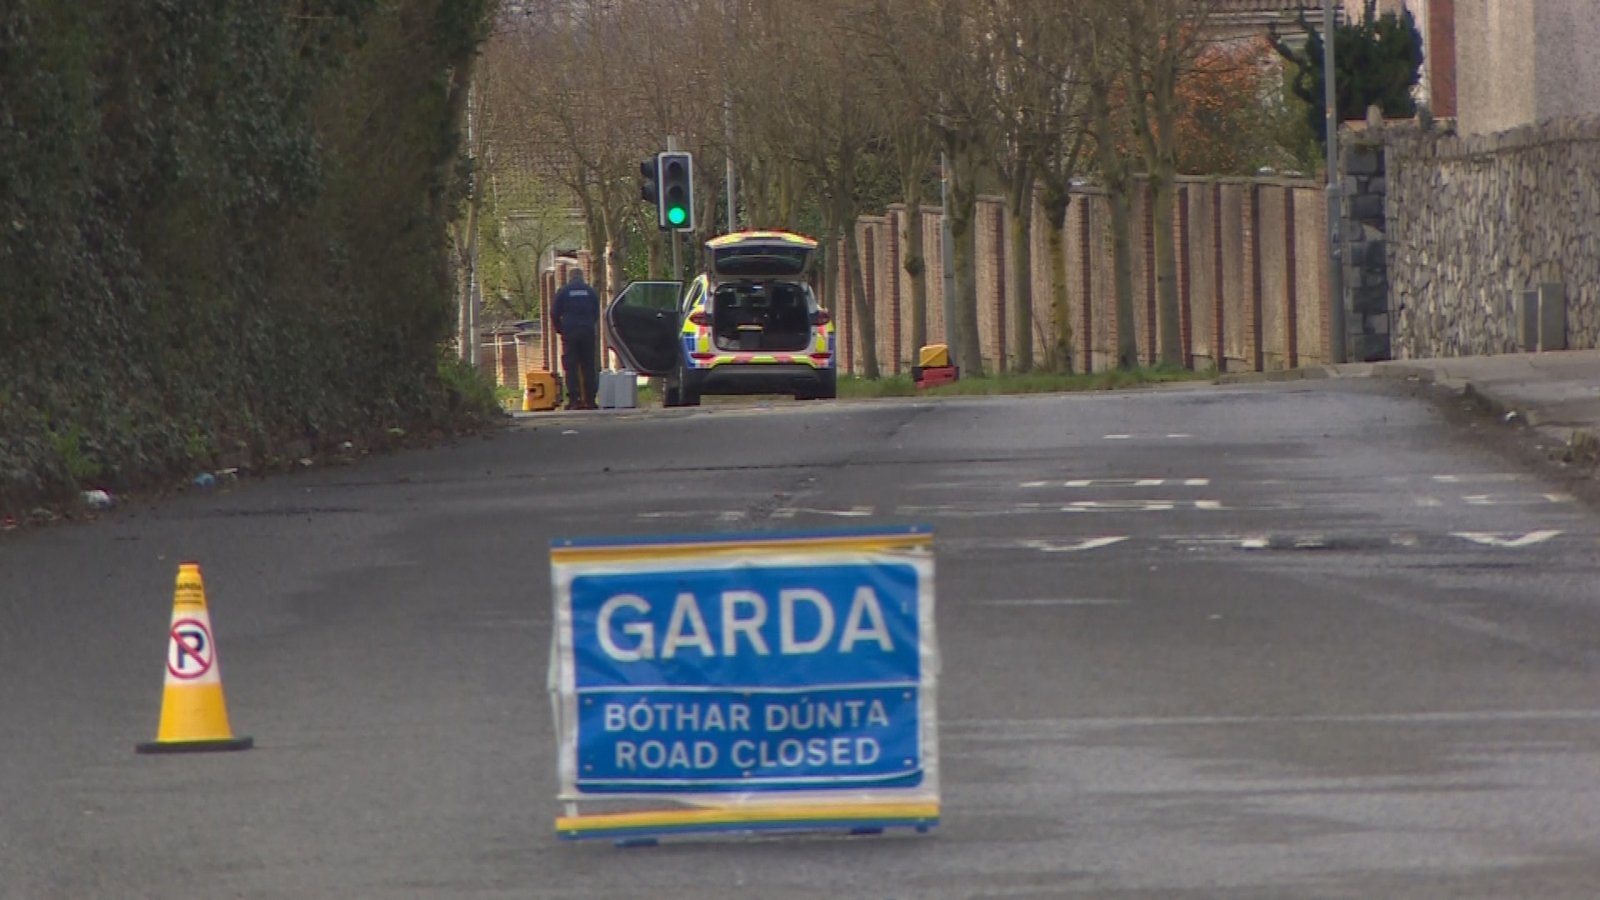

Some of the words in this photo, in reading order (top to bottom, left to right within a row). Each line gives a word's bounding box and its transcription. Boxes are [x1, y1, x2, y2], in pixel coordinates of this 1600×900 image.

[596, 586, 895, 662] GARDA
[177, 630, 205, 669] P
[604, 697, 750, 732] BÓTHAR
[766, 697, 890, 732] DÚNTA
[615, 740, 718, 770] ROAD
[731, 737, 881, 769] CLOSED
